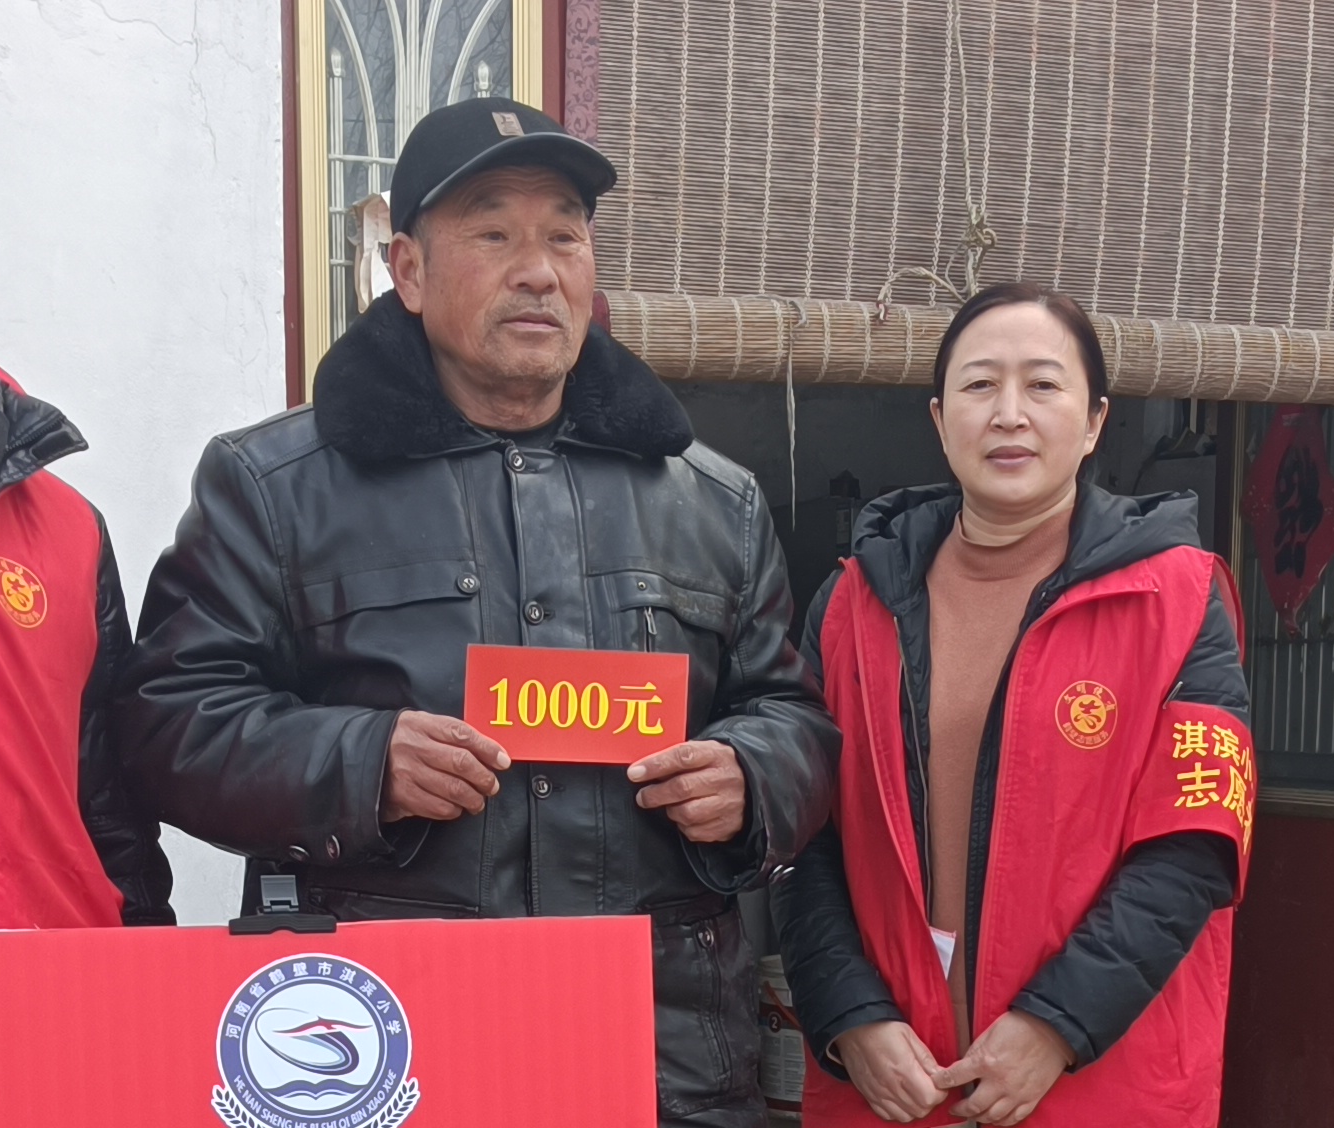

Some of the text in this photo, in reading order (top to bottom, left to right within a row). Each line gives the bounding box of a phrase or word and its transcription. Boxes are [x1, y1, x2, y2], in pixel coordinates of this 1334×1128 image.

[489, 677, 664, 735] 1000元
[225, 961, 402, 1039] 河南省鹤壁市淇滨小学
[234, 1074, 245, 1092] HE
[242, 1091, 262, 1115] NAN
[350, 1108, 368, 1126] BIN
[365, 1091, 386, 1115] XIAO
[384, 1070, 398, 1094] XUE
